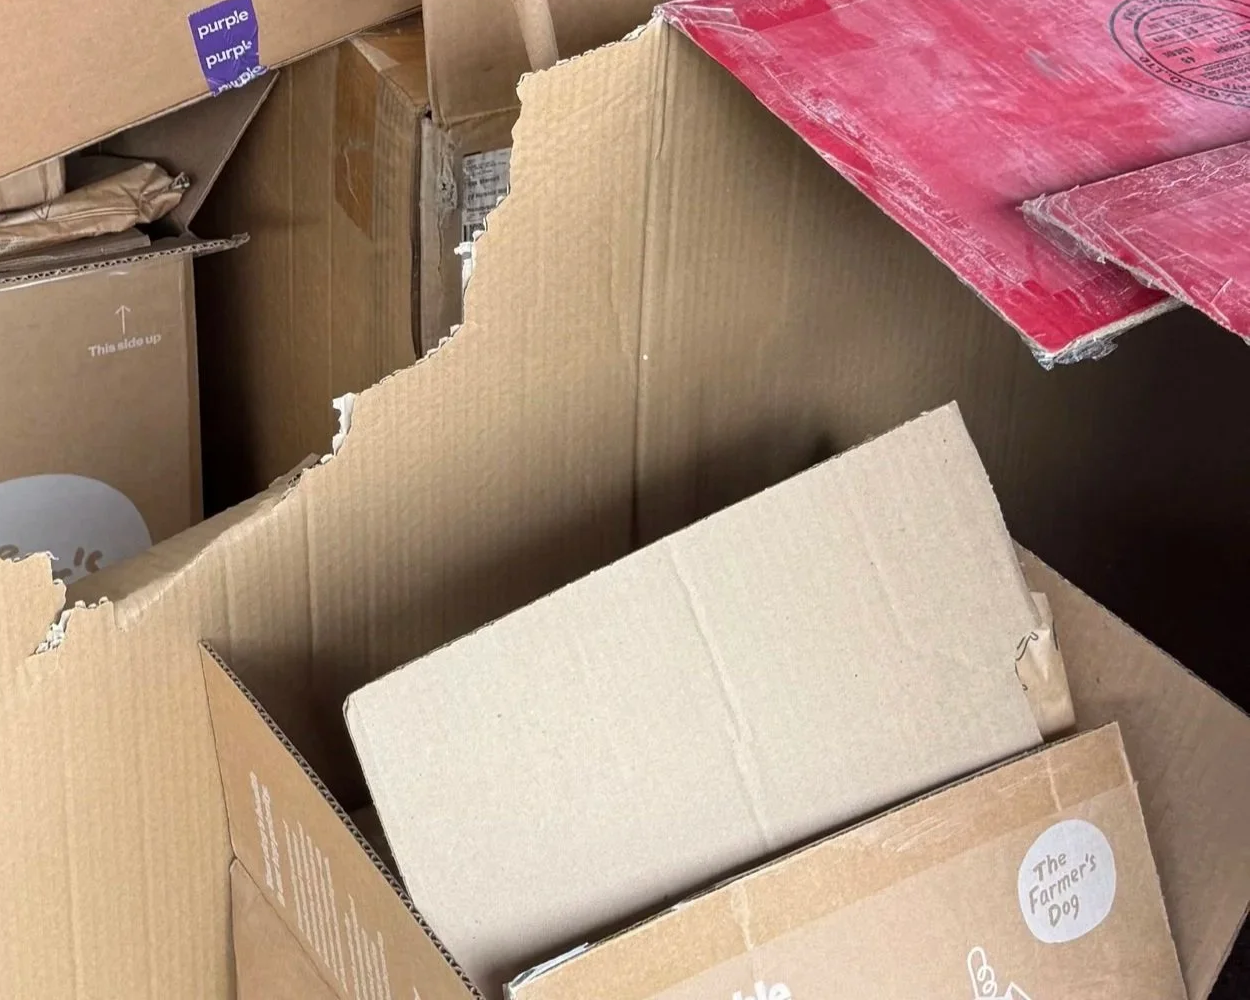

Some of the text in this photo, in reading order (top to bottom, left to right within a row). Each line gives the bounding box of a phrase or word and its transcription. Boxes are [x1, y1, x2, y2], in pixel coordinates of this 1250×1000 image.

[197, 10, 249, 40] purple
[88, 334, 162, 357] This side up
[1032, 853, 1067, 881] The
[1028, 853, 1097, 915] Farmer's
[1048, 894, 1080, 927] Dog
